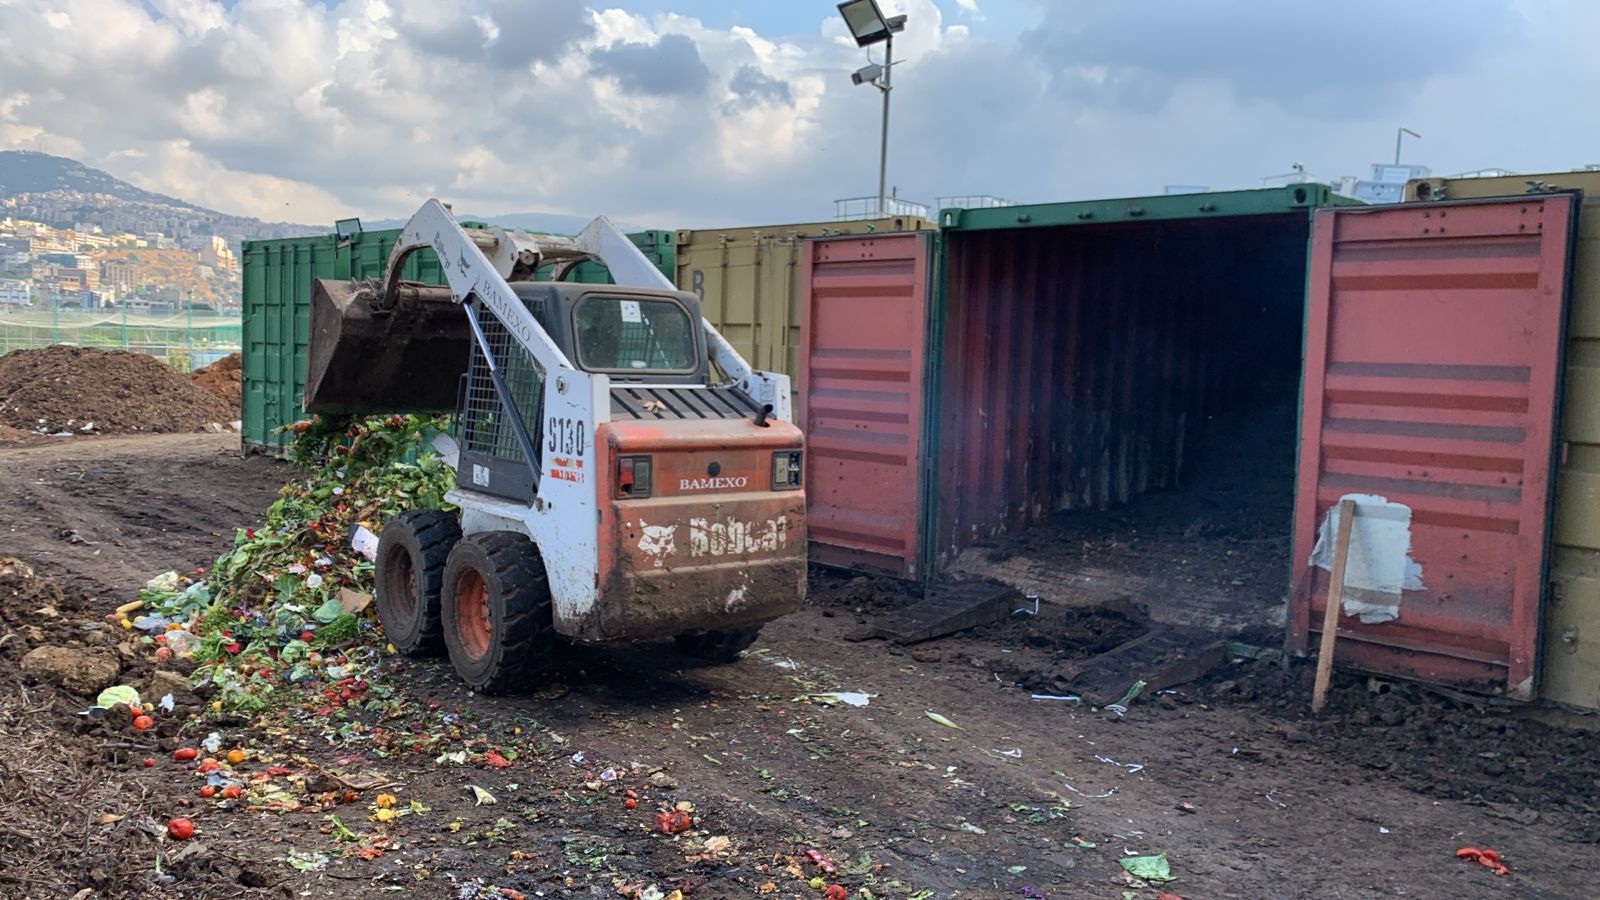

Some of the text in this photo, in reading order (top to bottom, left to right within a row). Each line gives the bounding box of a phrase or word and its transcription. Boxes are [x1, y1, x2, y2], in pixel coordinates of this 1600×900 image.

[482, 280, 531, 342] BAMEXO
[548, 416, 585, 457] S130
[679, 475, 747, 491] BAMEXO
